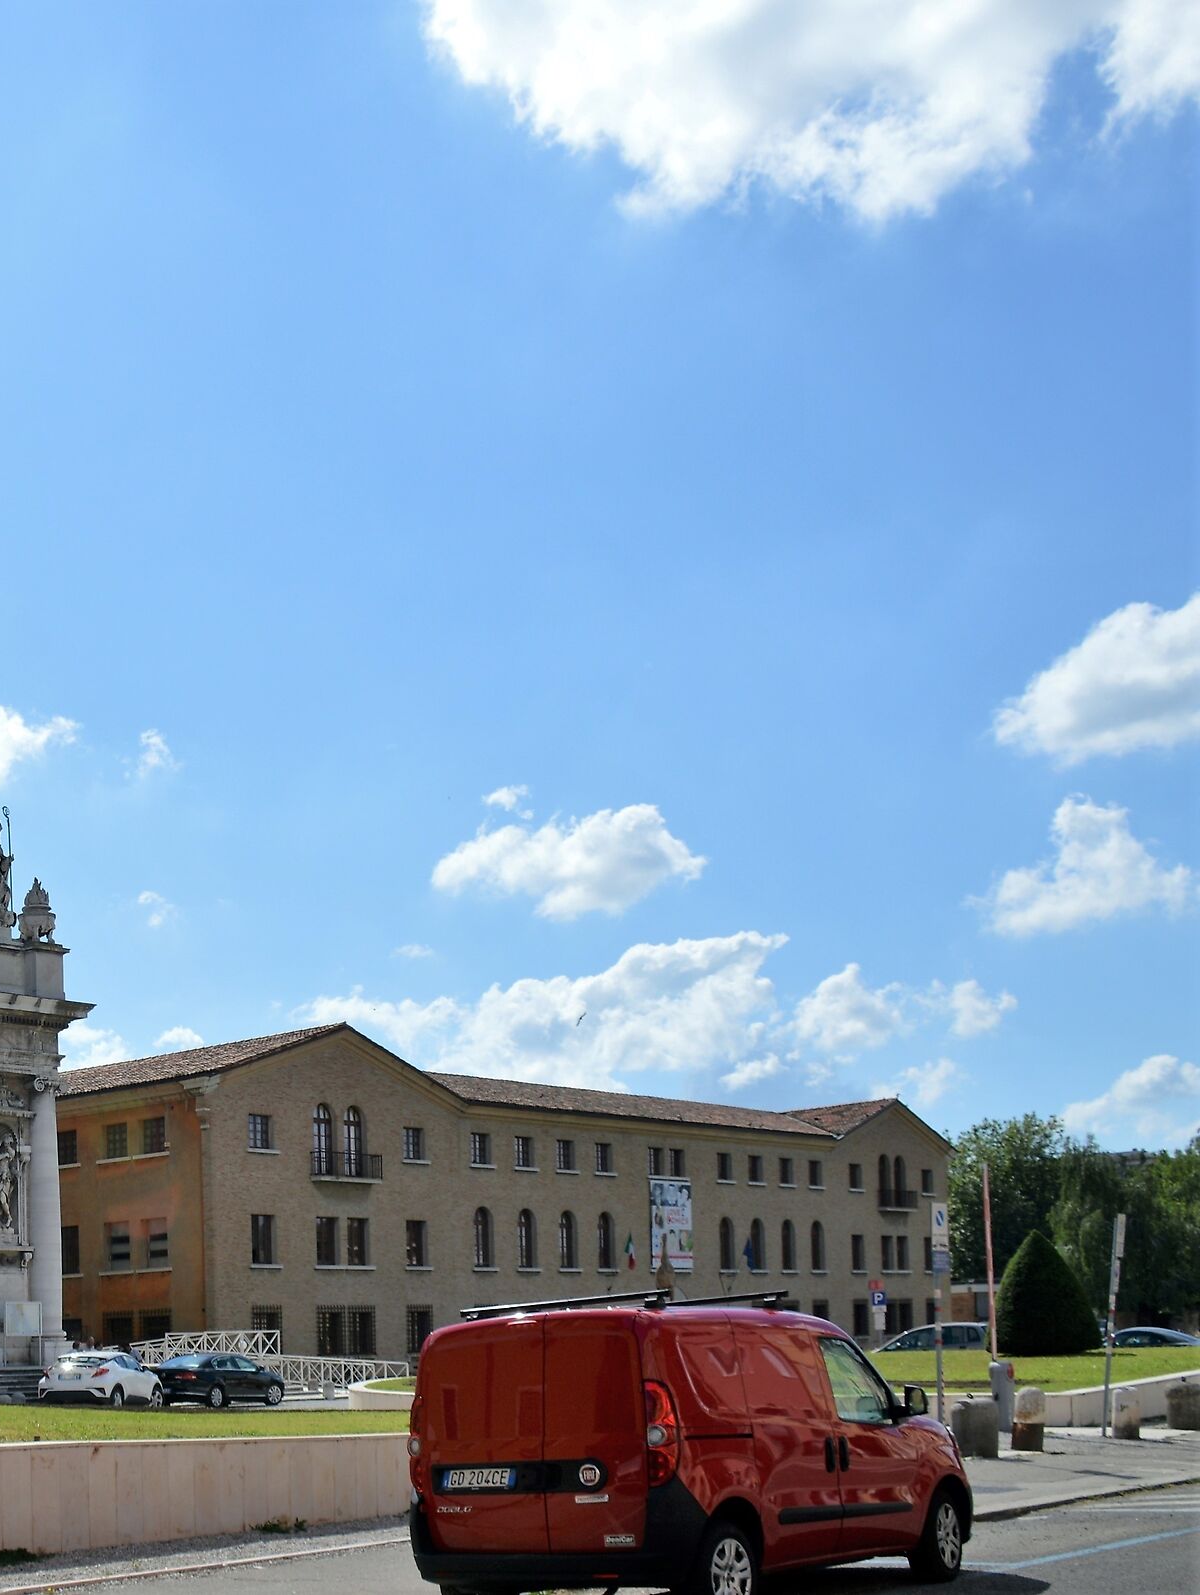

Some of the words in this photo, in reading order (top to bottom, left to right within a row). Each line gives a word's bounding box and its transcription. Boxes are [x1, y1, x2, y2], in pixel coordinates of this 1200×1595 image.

[874, 1292, 884, 1305] P
[450, 1471, 465, 1486] GD
[468, 1470, 508, 1486] 204CE
[583, 1469, 596, 1481] FIAT
